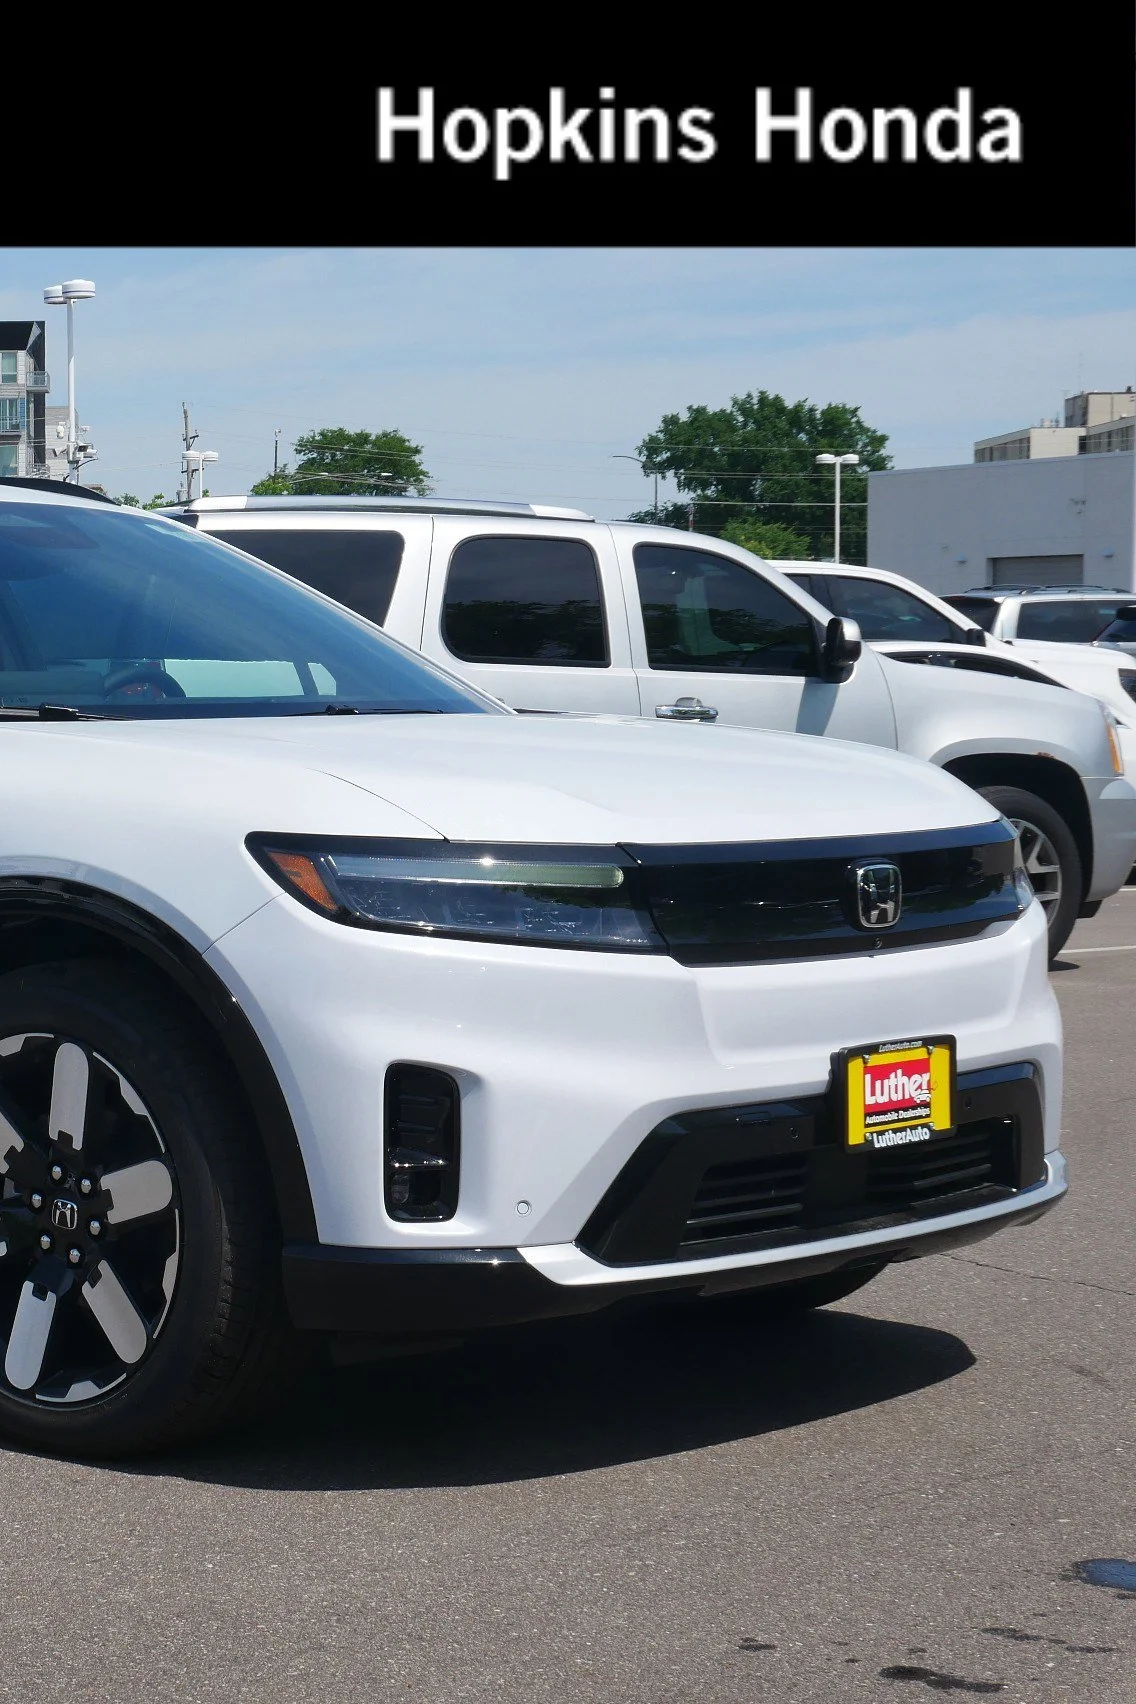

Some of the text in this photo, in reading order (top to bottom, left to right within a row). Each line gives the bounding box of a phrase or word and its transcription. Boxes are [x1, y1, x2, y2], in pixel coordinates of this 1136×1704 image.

[878, 1040, 923, 1053] LutherAuto.com
[864, 1068, 931, 1105] Luther
[865, 1106, 931, 1125] Automobile Dealerships
[873, 1126, 931, 1148] LutherAuto
